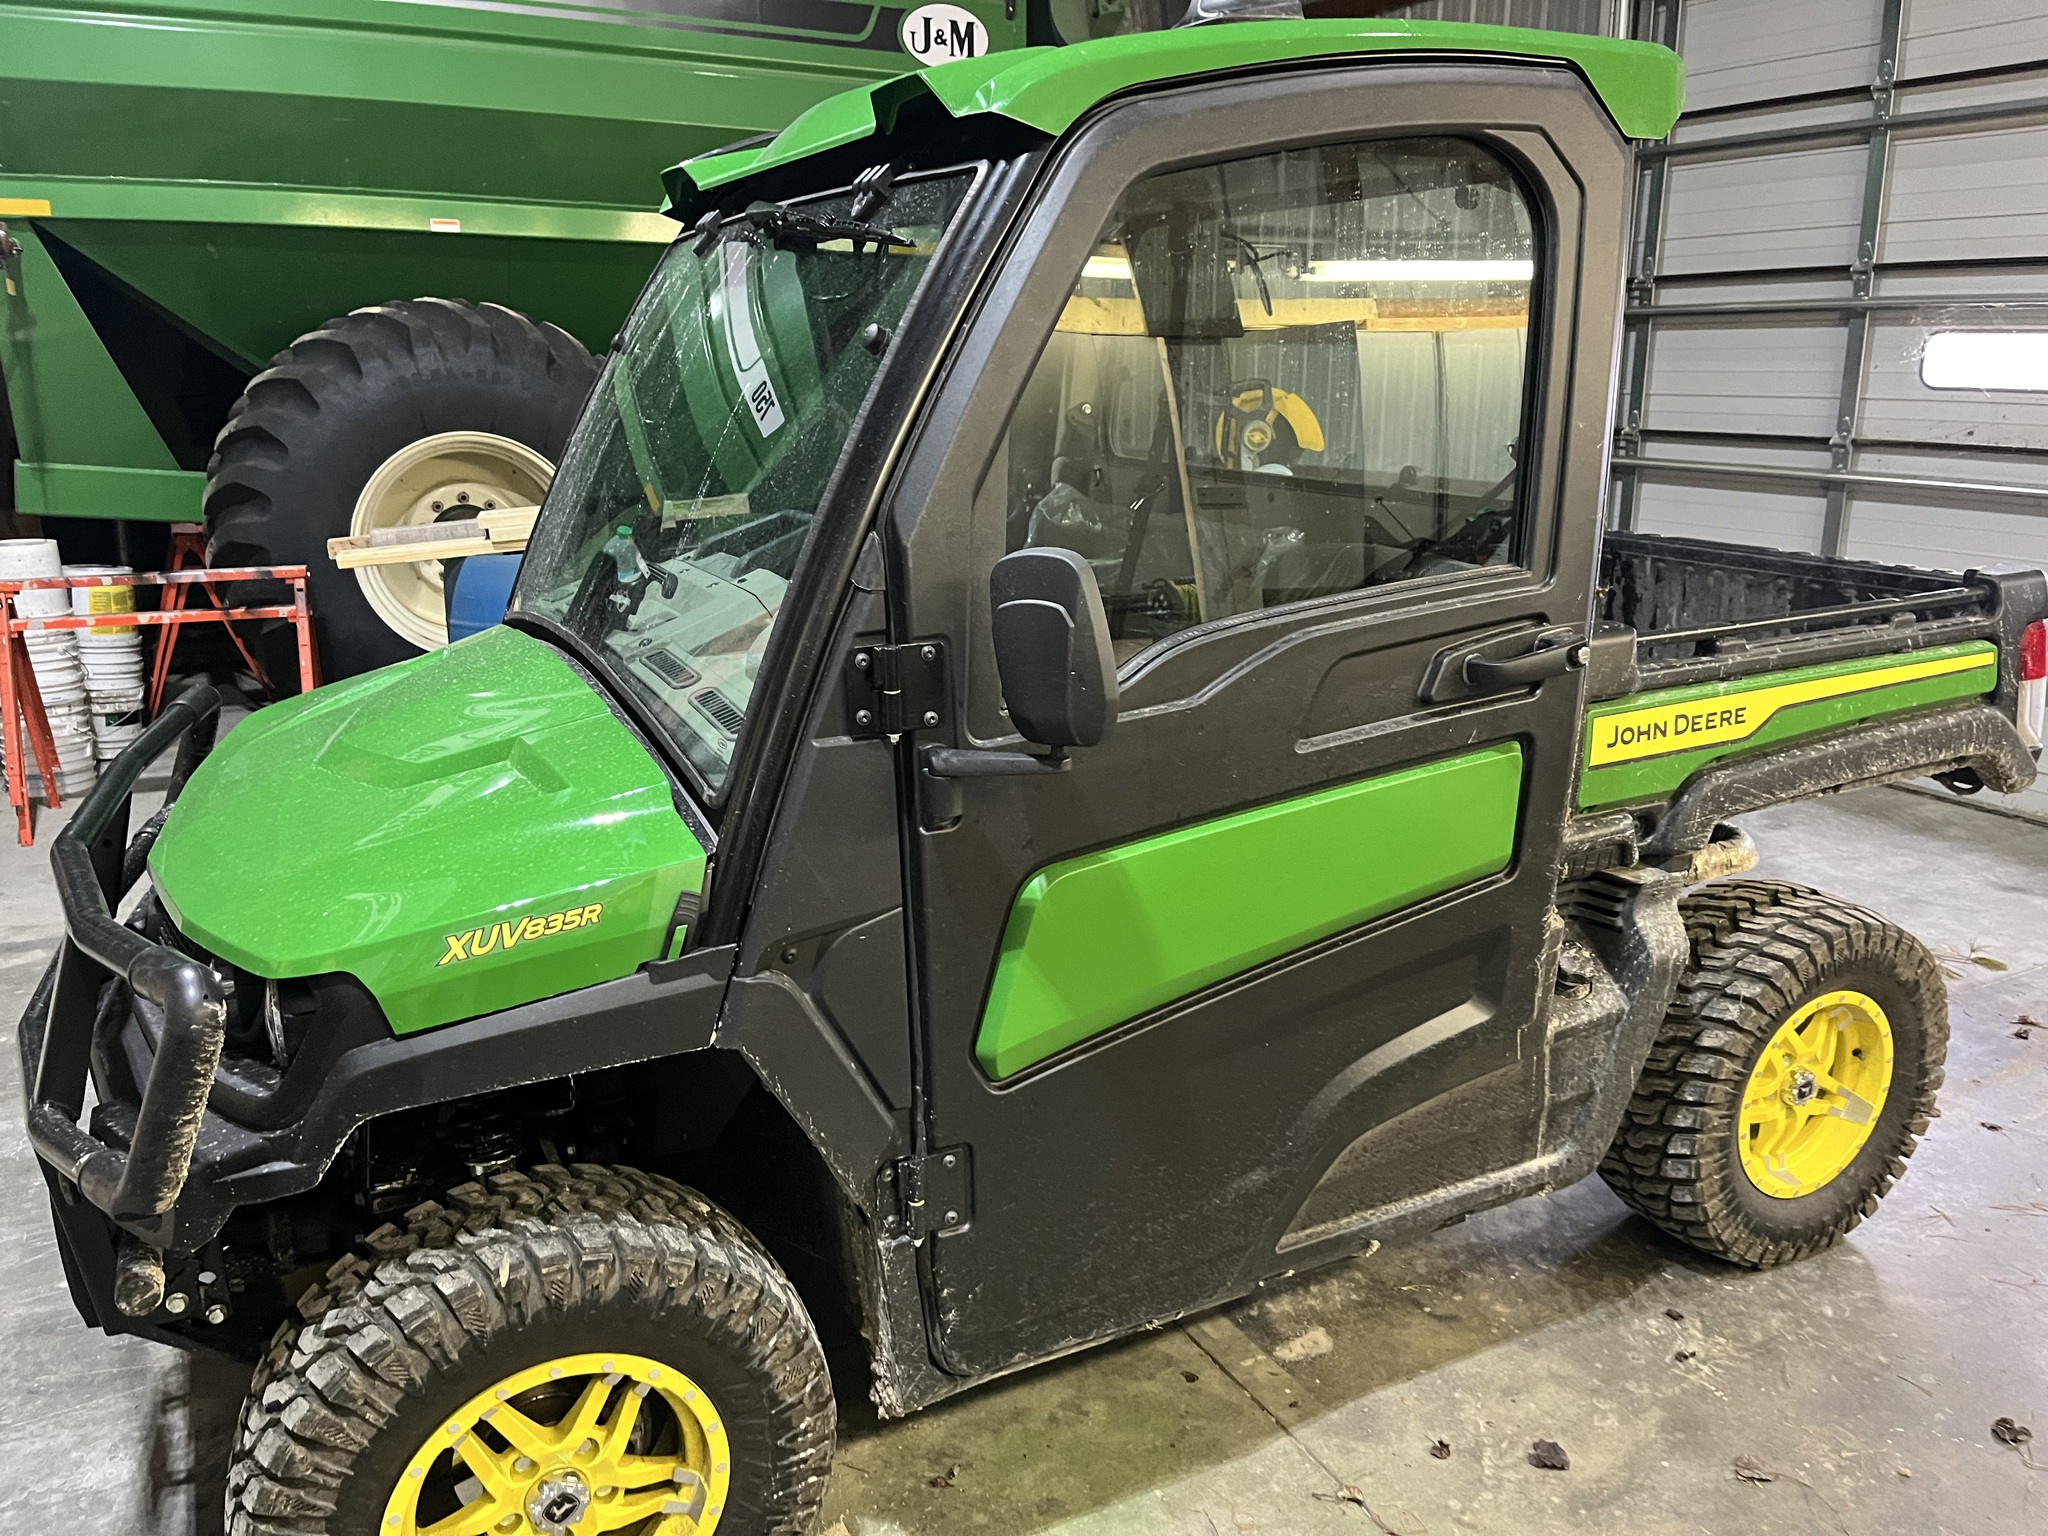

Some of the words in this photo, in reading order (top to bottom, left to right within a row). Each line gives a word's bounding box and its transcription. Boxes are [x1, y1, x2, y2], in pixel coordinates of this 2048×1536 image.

[910, 16, 975, 58] J&M
[1607, 721, 1667, 748] JOHN
[1674, 707, 1746, 736] DEERE
[435, 903, 603, 967] XUV835R
